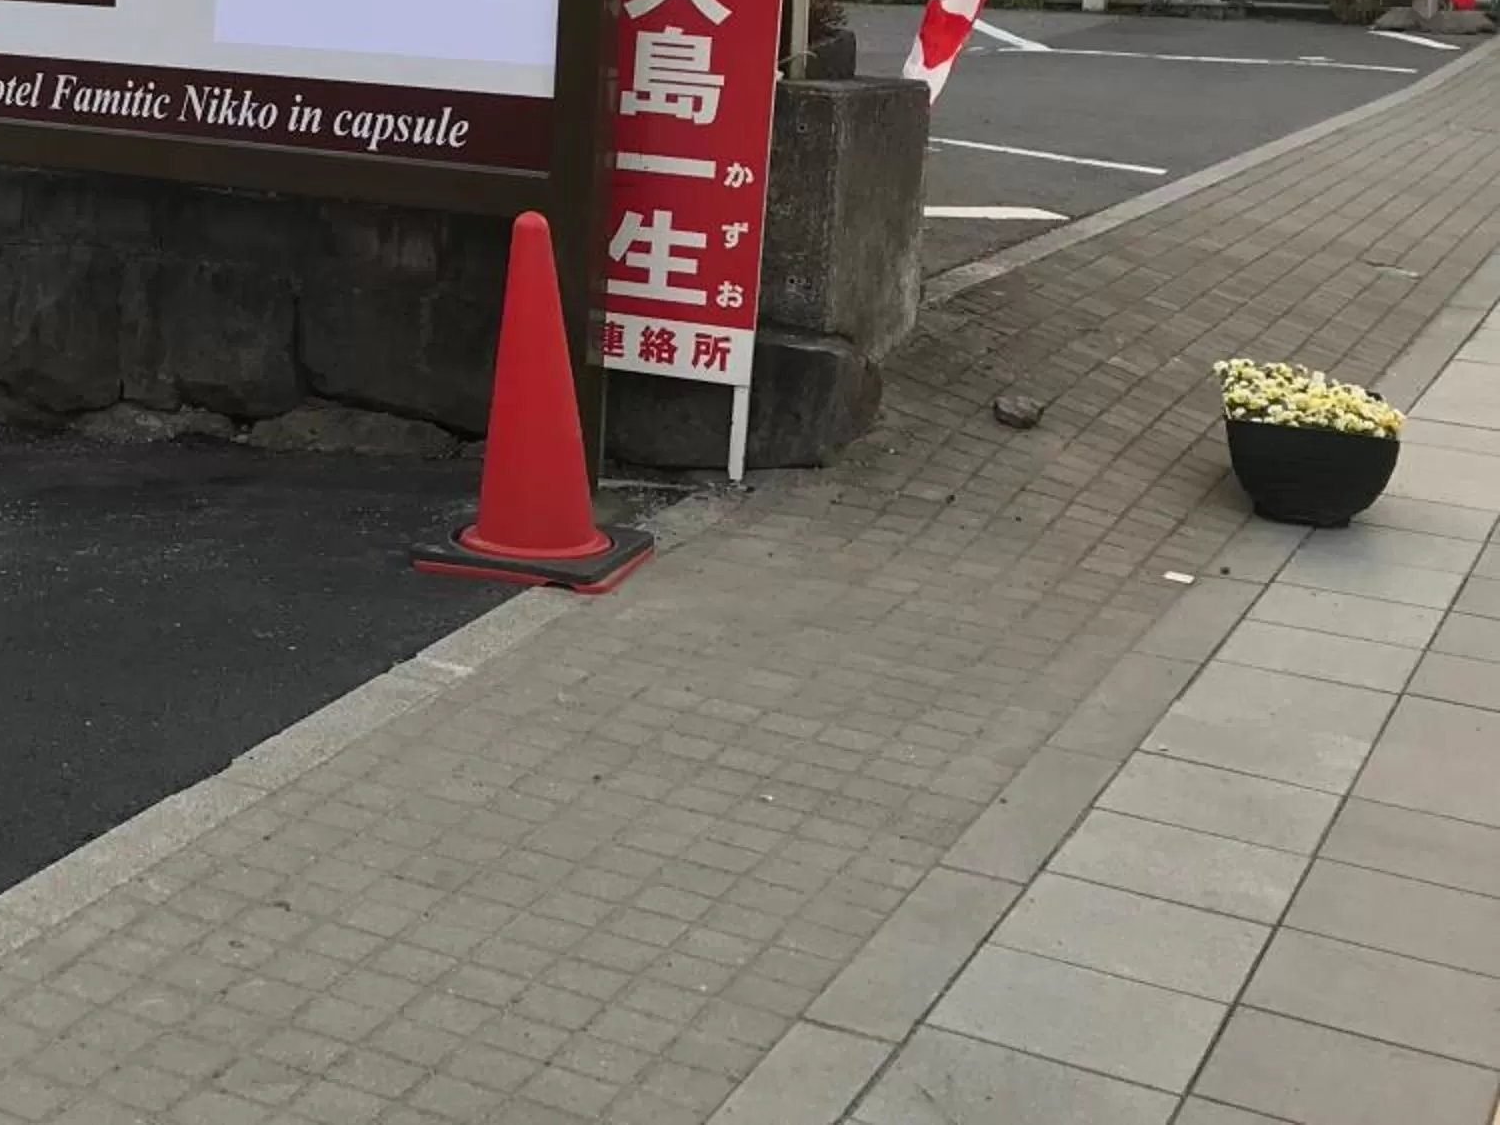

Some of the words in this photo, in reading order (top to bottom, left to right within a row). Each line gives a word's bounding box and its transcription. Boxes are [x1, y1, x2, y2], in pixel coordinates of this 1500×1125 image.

[51, 74, 171, 120] Famitic
[178, 84, 278, 131] Nikko
[287, 94, 322, 135] in
[333, 107, 470, 151] capsule
[715, 161, 754, 308] かずお
